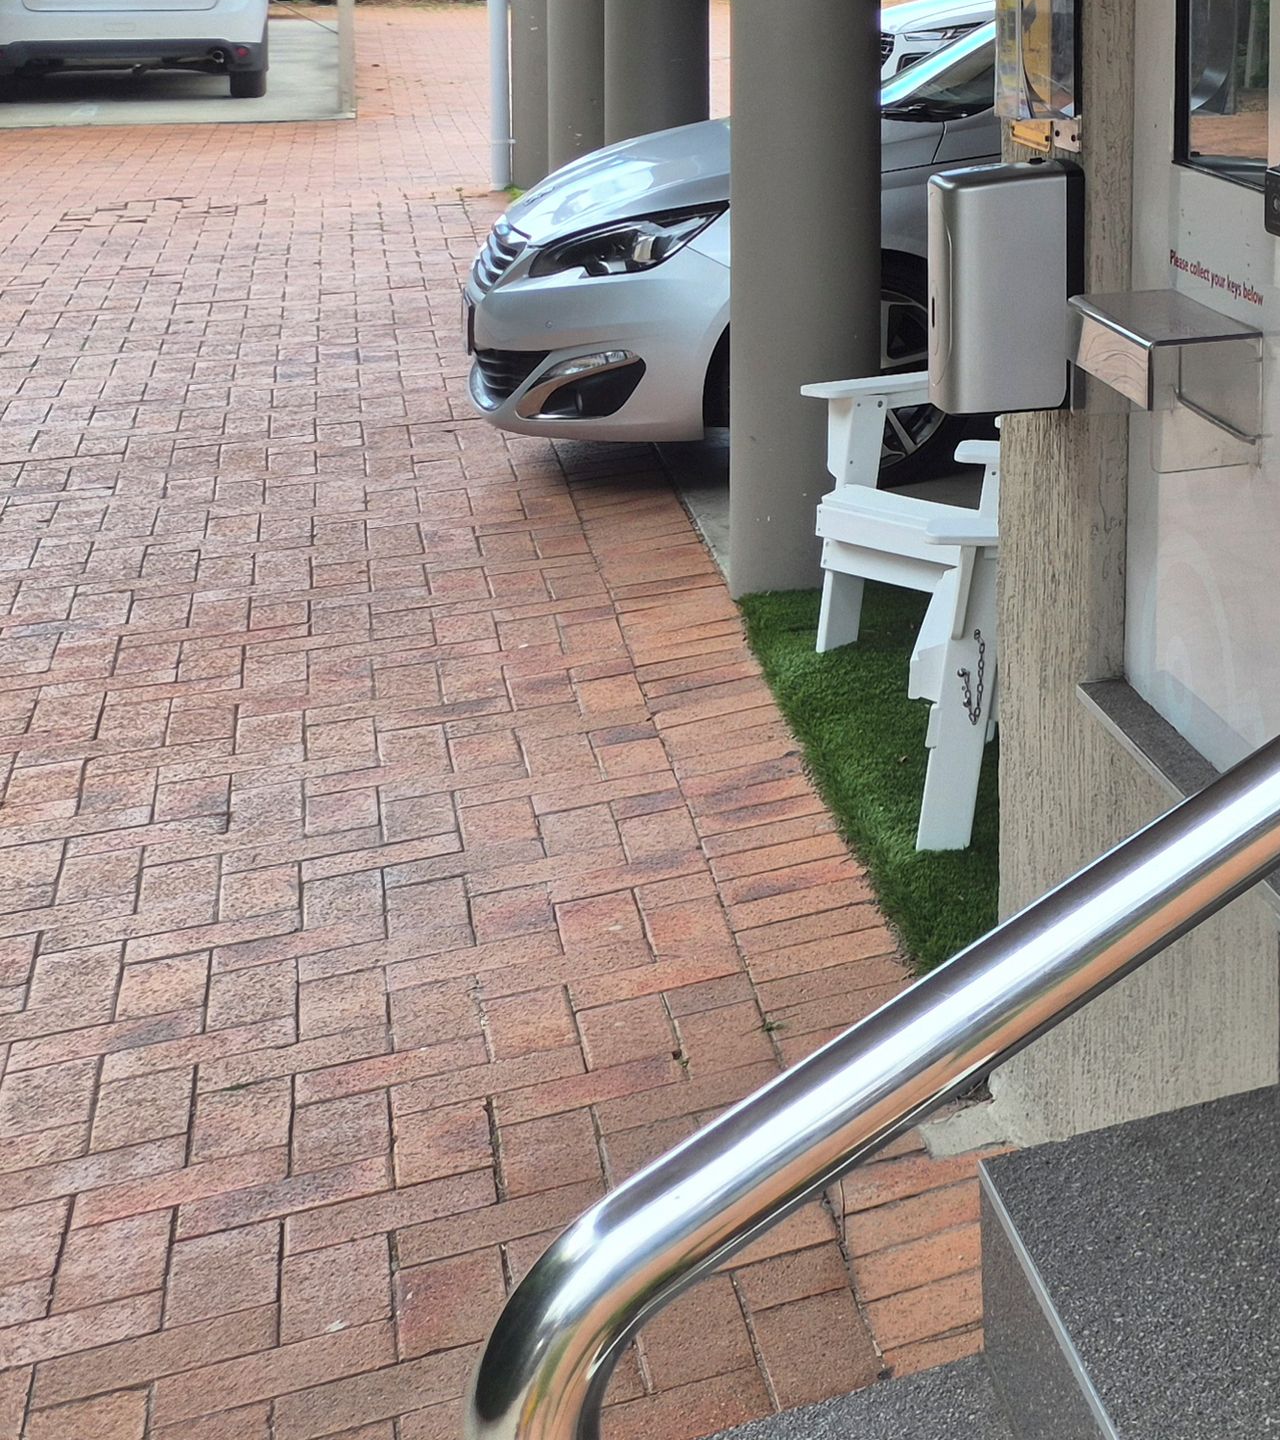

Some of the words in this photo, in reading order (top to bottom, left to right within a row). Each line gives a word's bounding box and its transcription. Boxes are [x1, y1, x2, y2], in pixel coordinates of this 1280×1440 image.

[1169, 248, 1189, 272] Please
[1189, 260, 1211, 282] collect
[1210, 272, 1226, 289] your
[1226, 274, 1242, 300] keys
[1242, 281, 1264, 306] below
